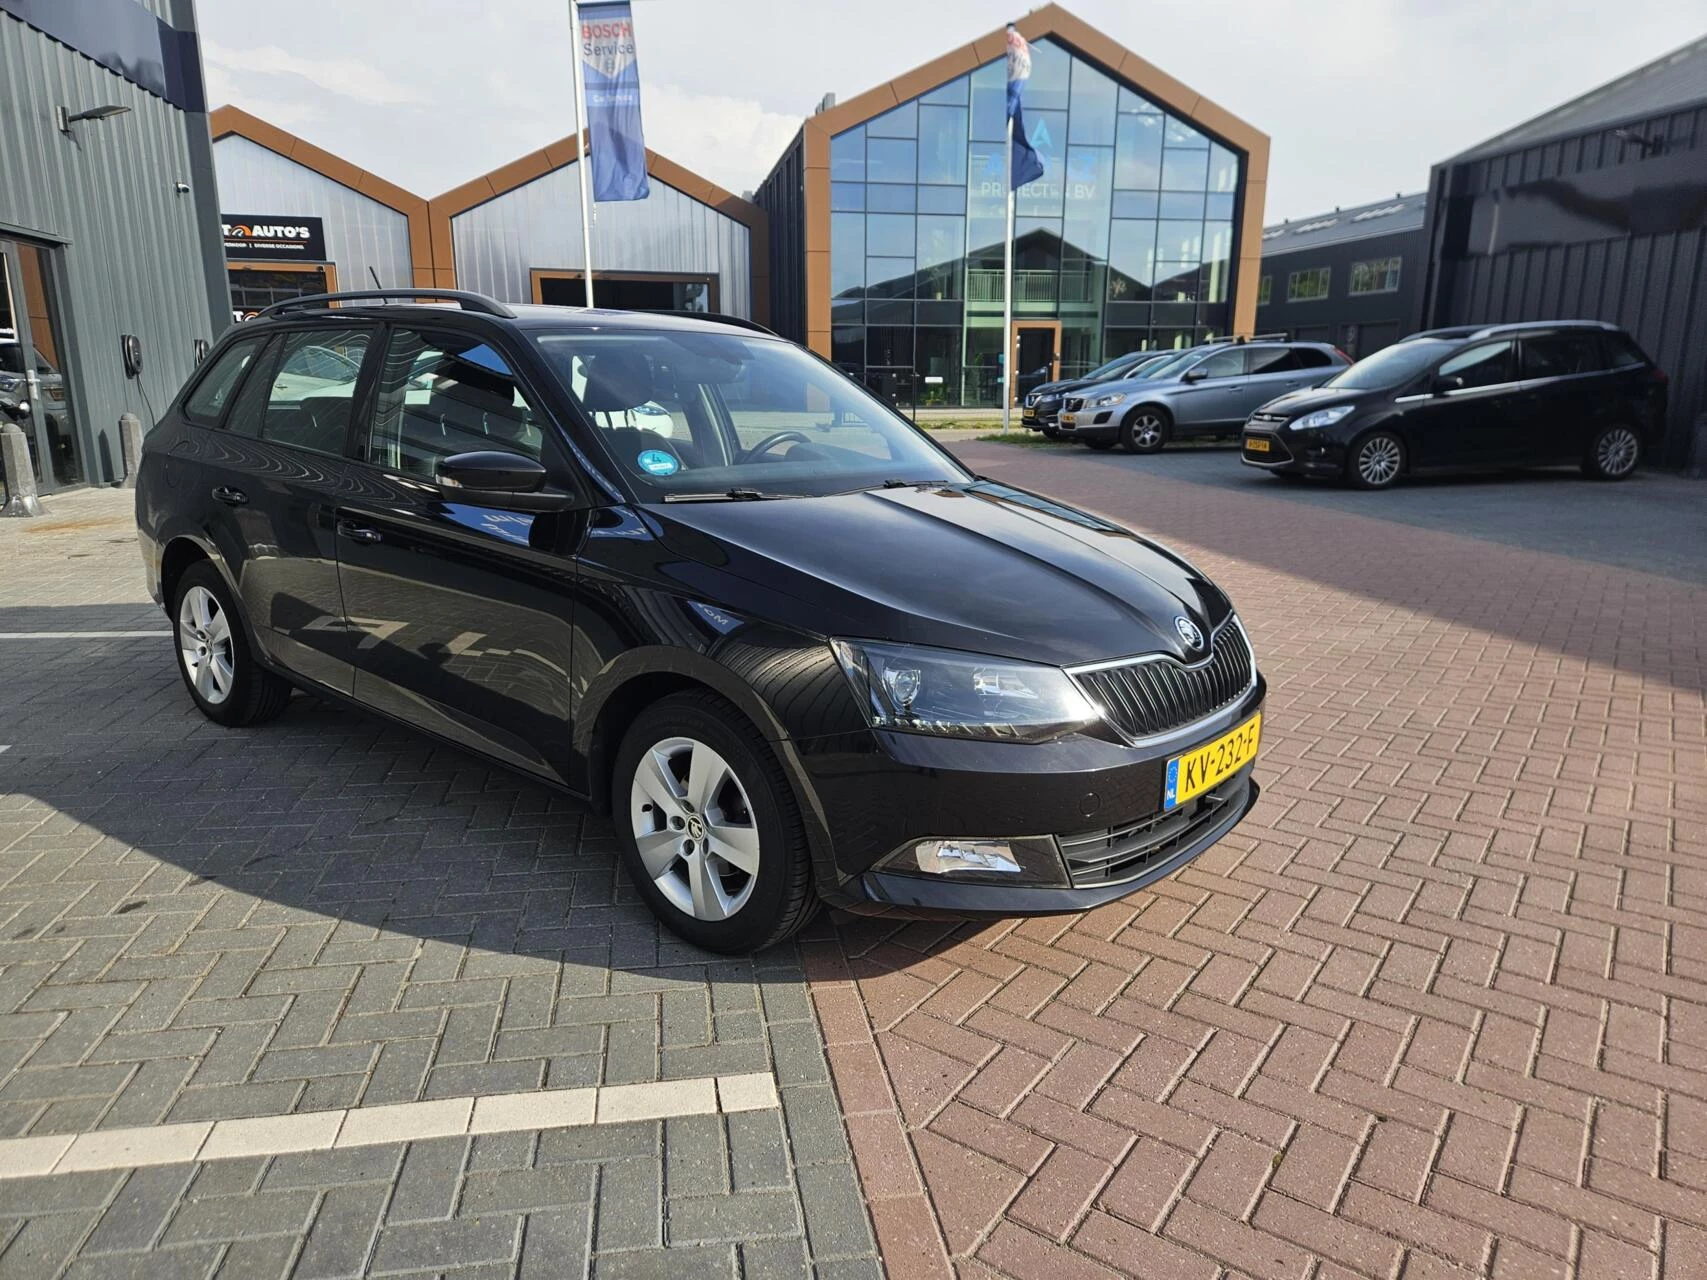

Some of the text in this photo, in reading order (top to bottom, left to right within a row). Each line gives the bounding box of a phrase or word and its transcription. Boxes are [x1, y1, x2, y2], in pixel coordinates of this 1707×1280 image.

[582, 23, 631, 39] BOSCH
[583, 42, 634, 56] Service
[252, 225, 310, 238] AUTO'S
[1185, 724, 1255, 793] KV-232-F
